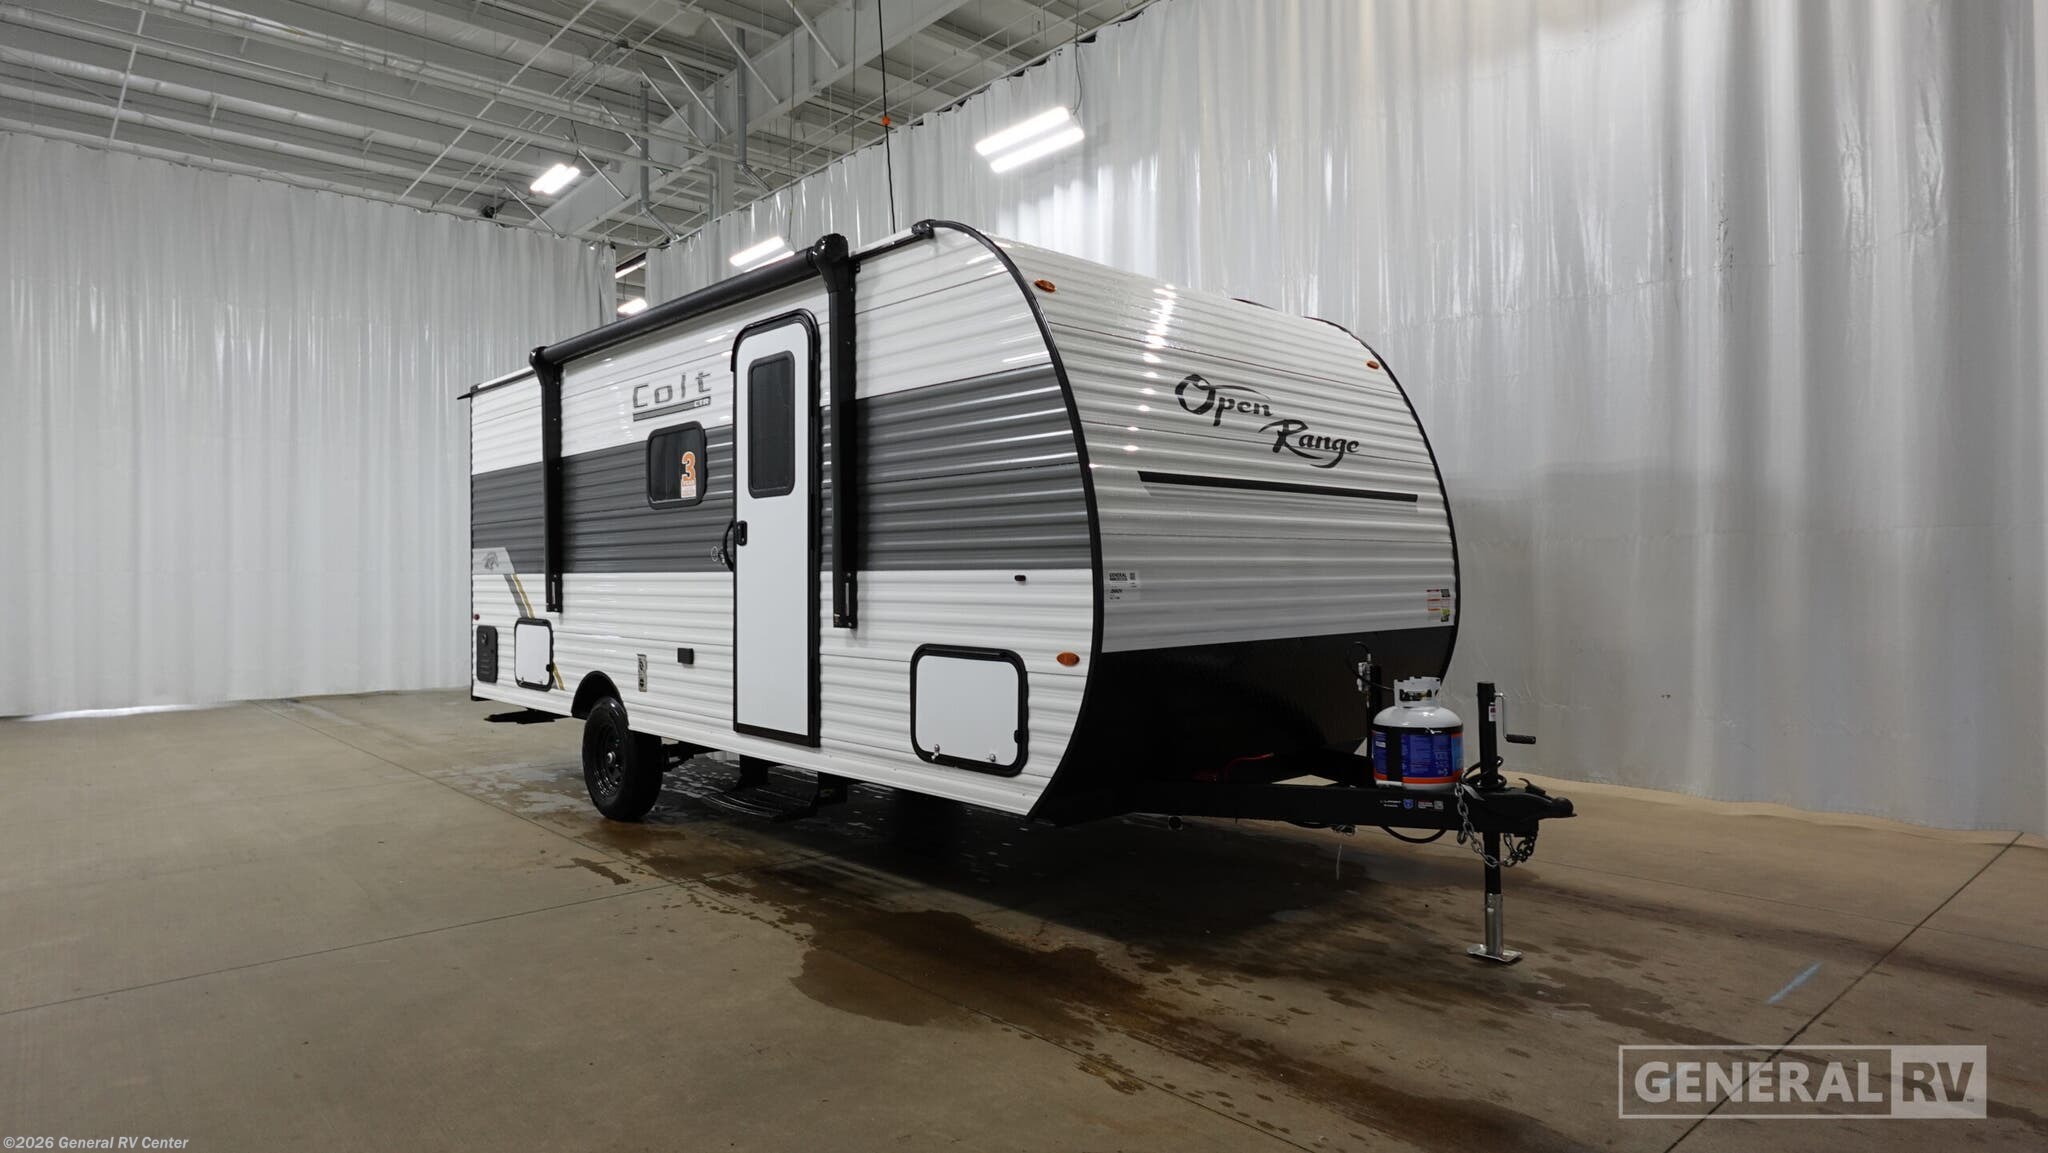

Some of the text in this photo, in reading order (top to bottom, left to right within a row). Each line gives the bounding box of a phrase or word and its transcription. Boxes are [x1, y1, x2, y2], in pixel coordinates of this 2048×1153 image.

[633, 371, 711, 408] Colt
[1175, 373, 1273, 426] Open
[1258, 419, 1359, 469] Range
[682, 451, 696, 481] 3
